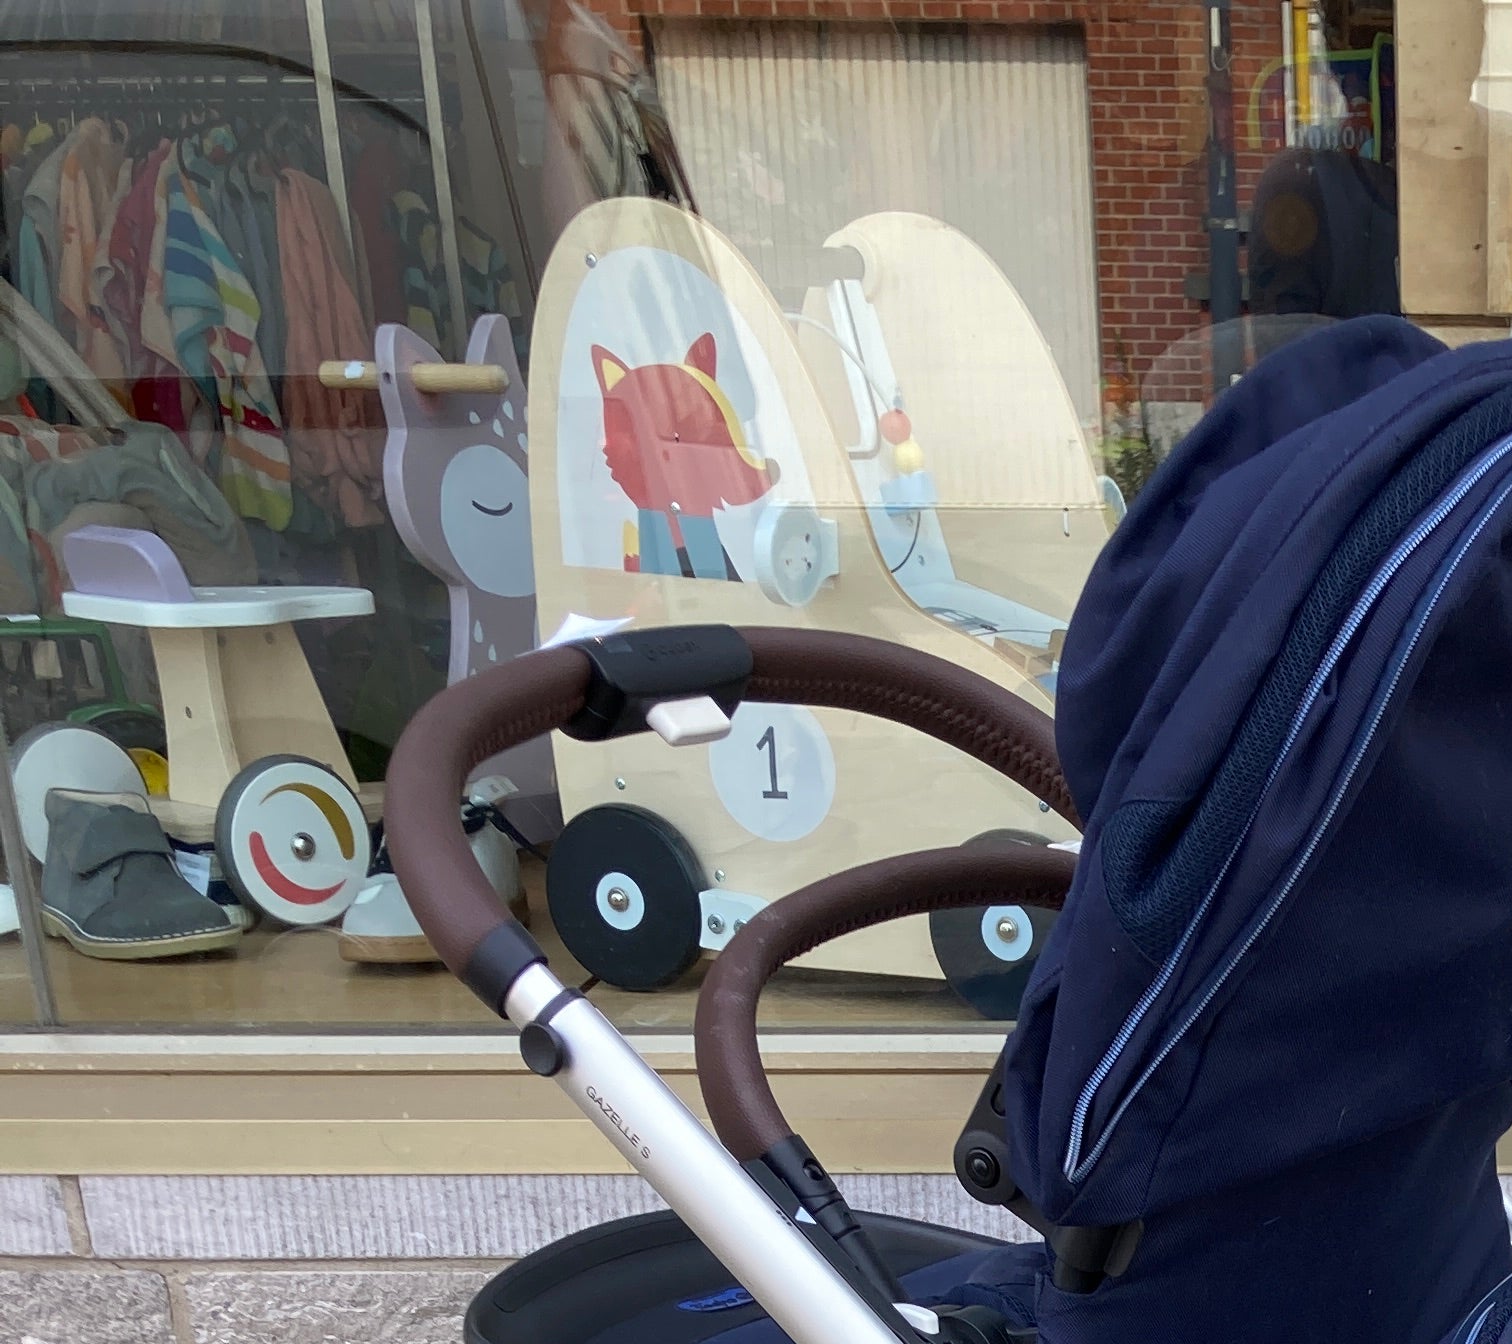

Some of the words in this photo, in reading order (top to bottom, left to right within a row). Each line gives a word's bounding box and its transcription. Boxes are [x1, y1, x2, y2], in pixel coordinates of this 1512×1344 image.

[756, 725, 789, 800] 1
[586, 1086, 641, 1149] GAZELLE
[640, 1146, 652, 1160] S
